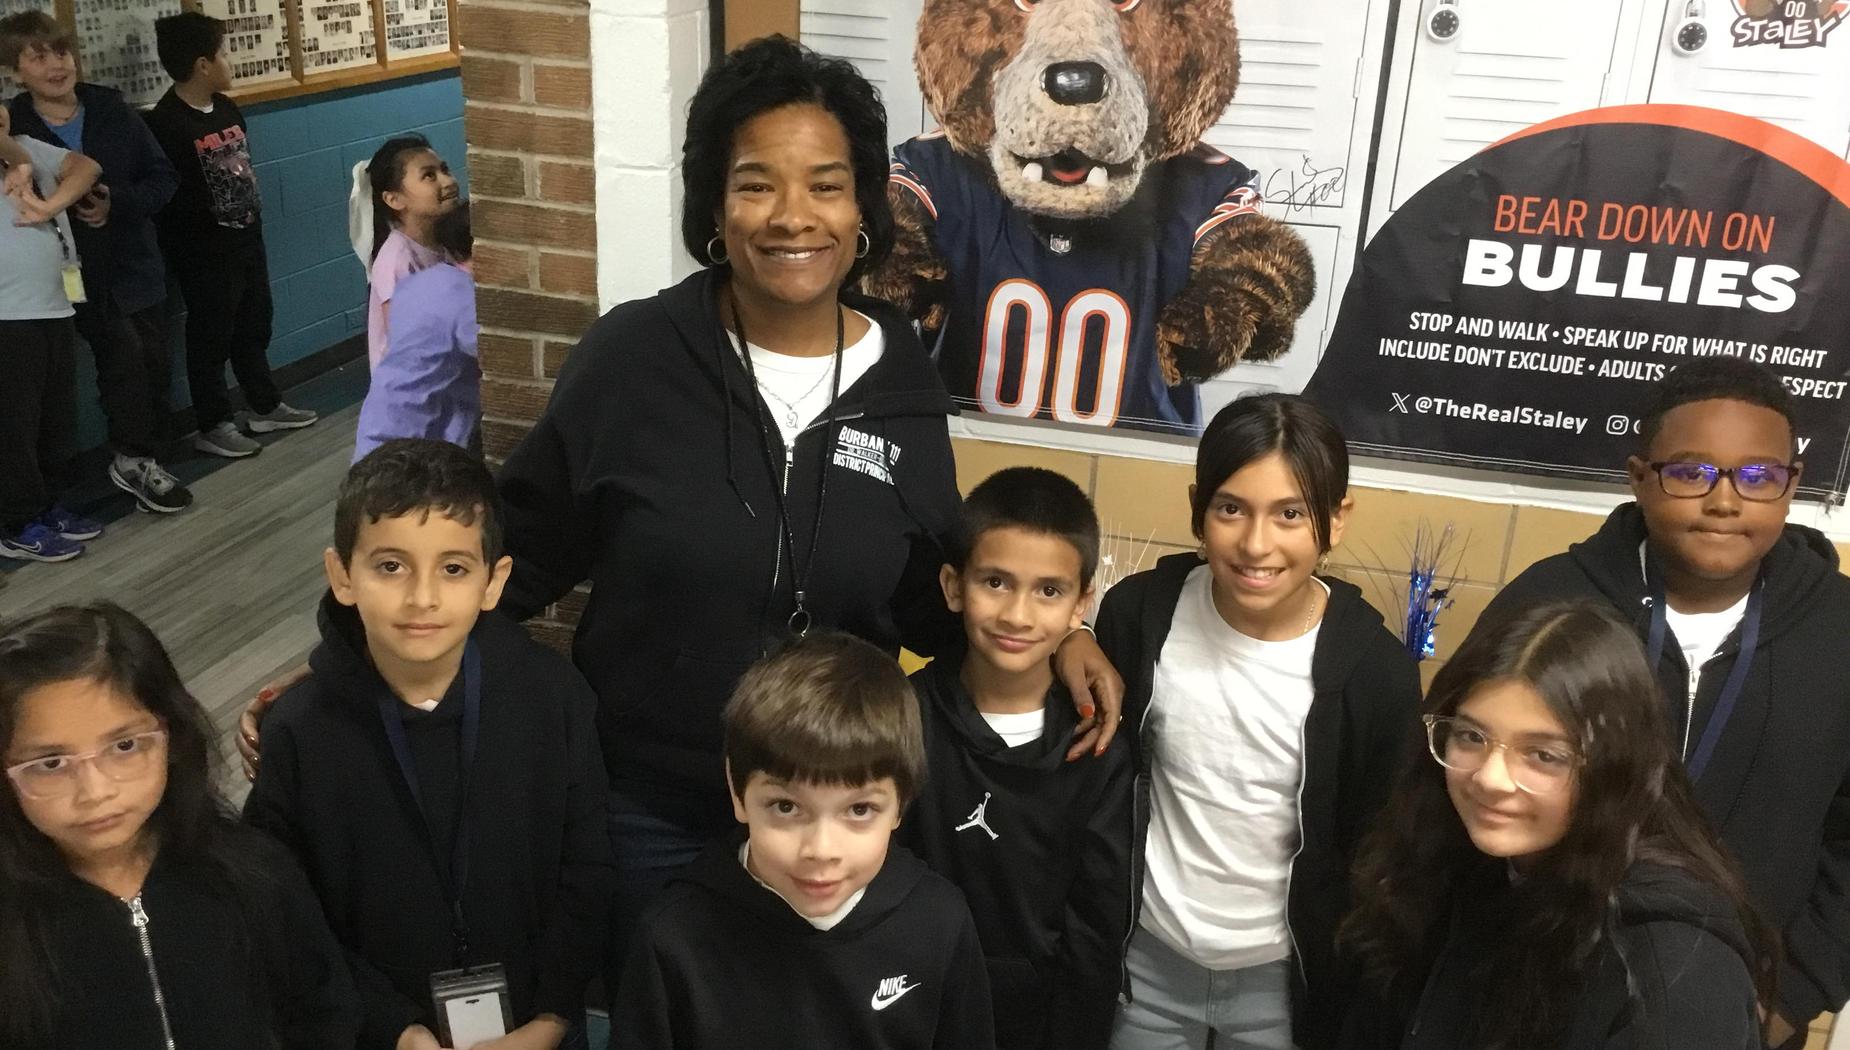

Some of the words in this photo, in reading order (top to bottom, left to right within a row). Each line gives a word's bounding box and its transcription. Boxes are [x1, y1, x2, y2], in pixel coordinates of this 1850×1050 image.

[1785, 1, 1806, 18] 00
[1494, 194, 1589, 238] BEAR
[1598, 203, 1713, 249] DOWN
[1721, 212, 1776, 254] ON
[1462, 238, 1801, 313] BULLIES
[976, 278, 1132, 428] 00
[1409, 311, 1454, 333] STOP
[1455, 316, 1494, 338] AND
[1498, 320, 1550, 342] WALK
[1562, 326, 1622, 349] SPEAK
[1623, 330, 1650, 351] UP
[1652, 334, 1688, 355] FOR
[1692, 337, 1747, 359] WHAT
[1750, 344, 1769, 364] IS
[1770, 346, 1828, 369] RIGHT
[1379, 338, 1452, 362] INCLUDE
[1454, 345, 1506, 368] DON'T
[1508, 351, 1587, 376] EXCLUDE
[1598, 358, 1666, 382] ADULTS
[1781, 376, 1848, 400] ESPECT
[838, 425, 890, 453] BURBAN
[1415, 396, 1589, 434] @TheRealStaley
[833, 452, 866, 473] DISTRICT
[877, 974, 908, 997] NIKE
